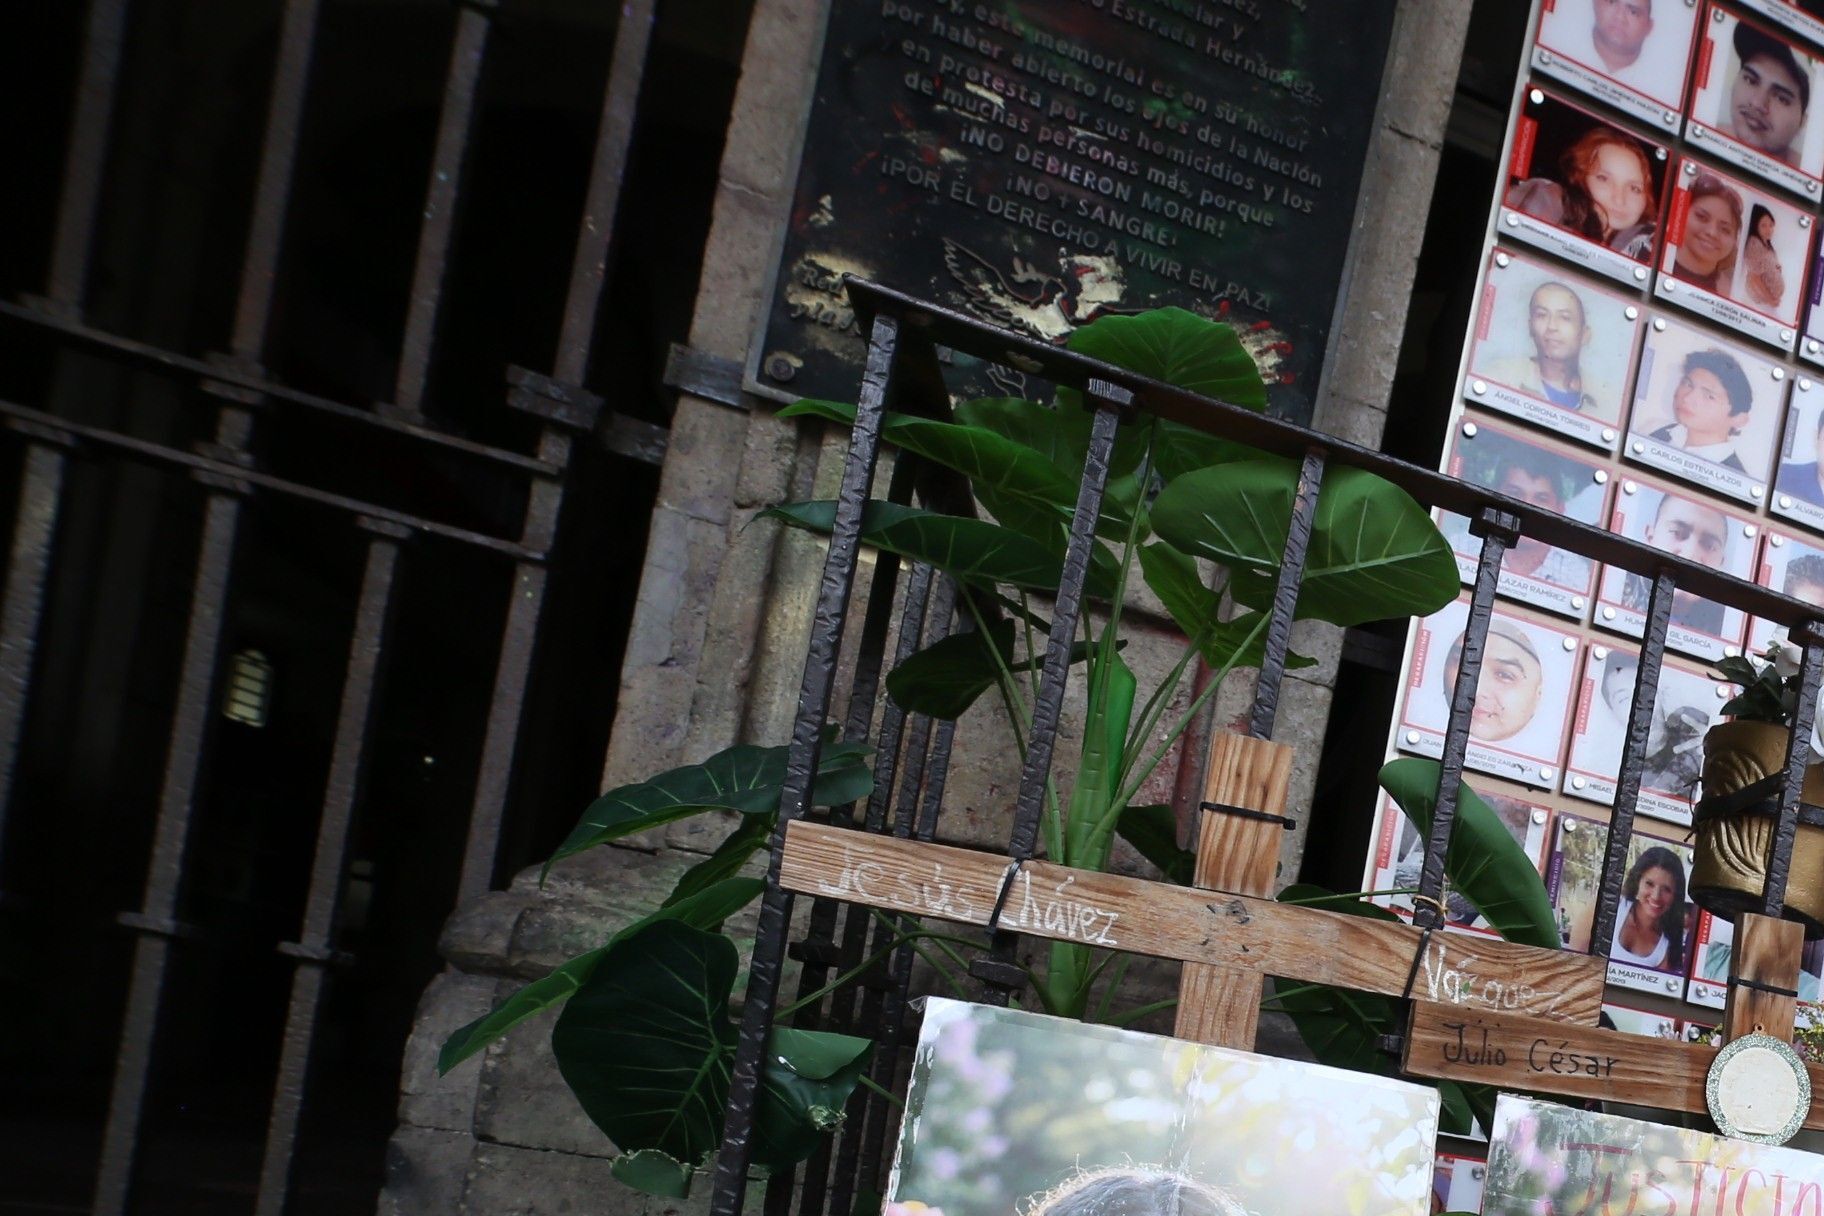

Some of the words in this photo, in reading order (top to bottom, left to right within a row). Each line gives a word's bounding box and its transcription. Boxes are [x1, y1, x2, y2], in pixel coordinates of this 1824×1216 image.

[1108, 5, 1202, 48] Estrada
[881, 1, 925, 27] por
[932, 14, 1004, 60] haber
[1011, 51, 1097, 98] abierto
[1104, 85, 1138, 114] los
[1197, 124, 1222, 149] de
[1230, 135, 1248, 159] la
[1252, 146, 1323, 189] Nación
[902, 37, 932, 64] en
[938, 54, 1043, 109] protesta
[1047, 99, 1089, 127] por
[1095, 115, 1132, 143] sus
[1135, 130, 1256, 193] homicidios
[1262, 181, 1276, 203] y
[1281, 188, 1315, 216] los
[904, 70, 934, 97] de
[941, 84, 1030, 134] muchas
[1036, 123, 1140, 177] personas
[1147, 164, 1193, 200] más,
[1199, 188, 1276, 230] porque
[1214, 102, 1238, 126] su
[1246, 114, 1310, 154] honor
[1014, 143, 1134, 205] DEBIERON
[1140, 192, 1228, 241] MORIR!
[986, 192, 1100, 251] DERECHO
[1104, 235, 1121, 259] A
[1126, 244, 1183, 283] VIVIR
[1188, 268, 1219, 296] EN
[1523, 401, 1559, 421] CORONA
[1650, 446, 1683, 465] CARLOS
[1617, 967, 1660, 985] MARTÍNEZ
[1442, 1022, 1507, 1067] Julio
[1528, 1037, 1621, 1079] César
